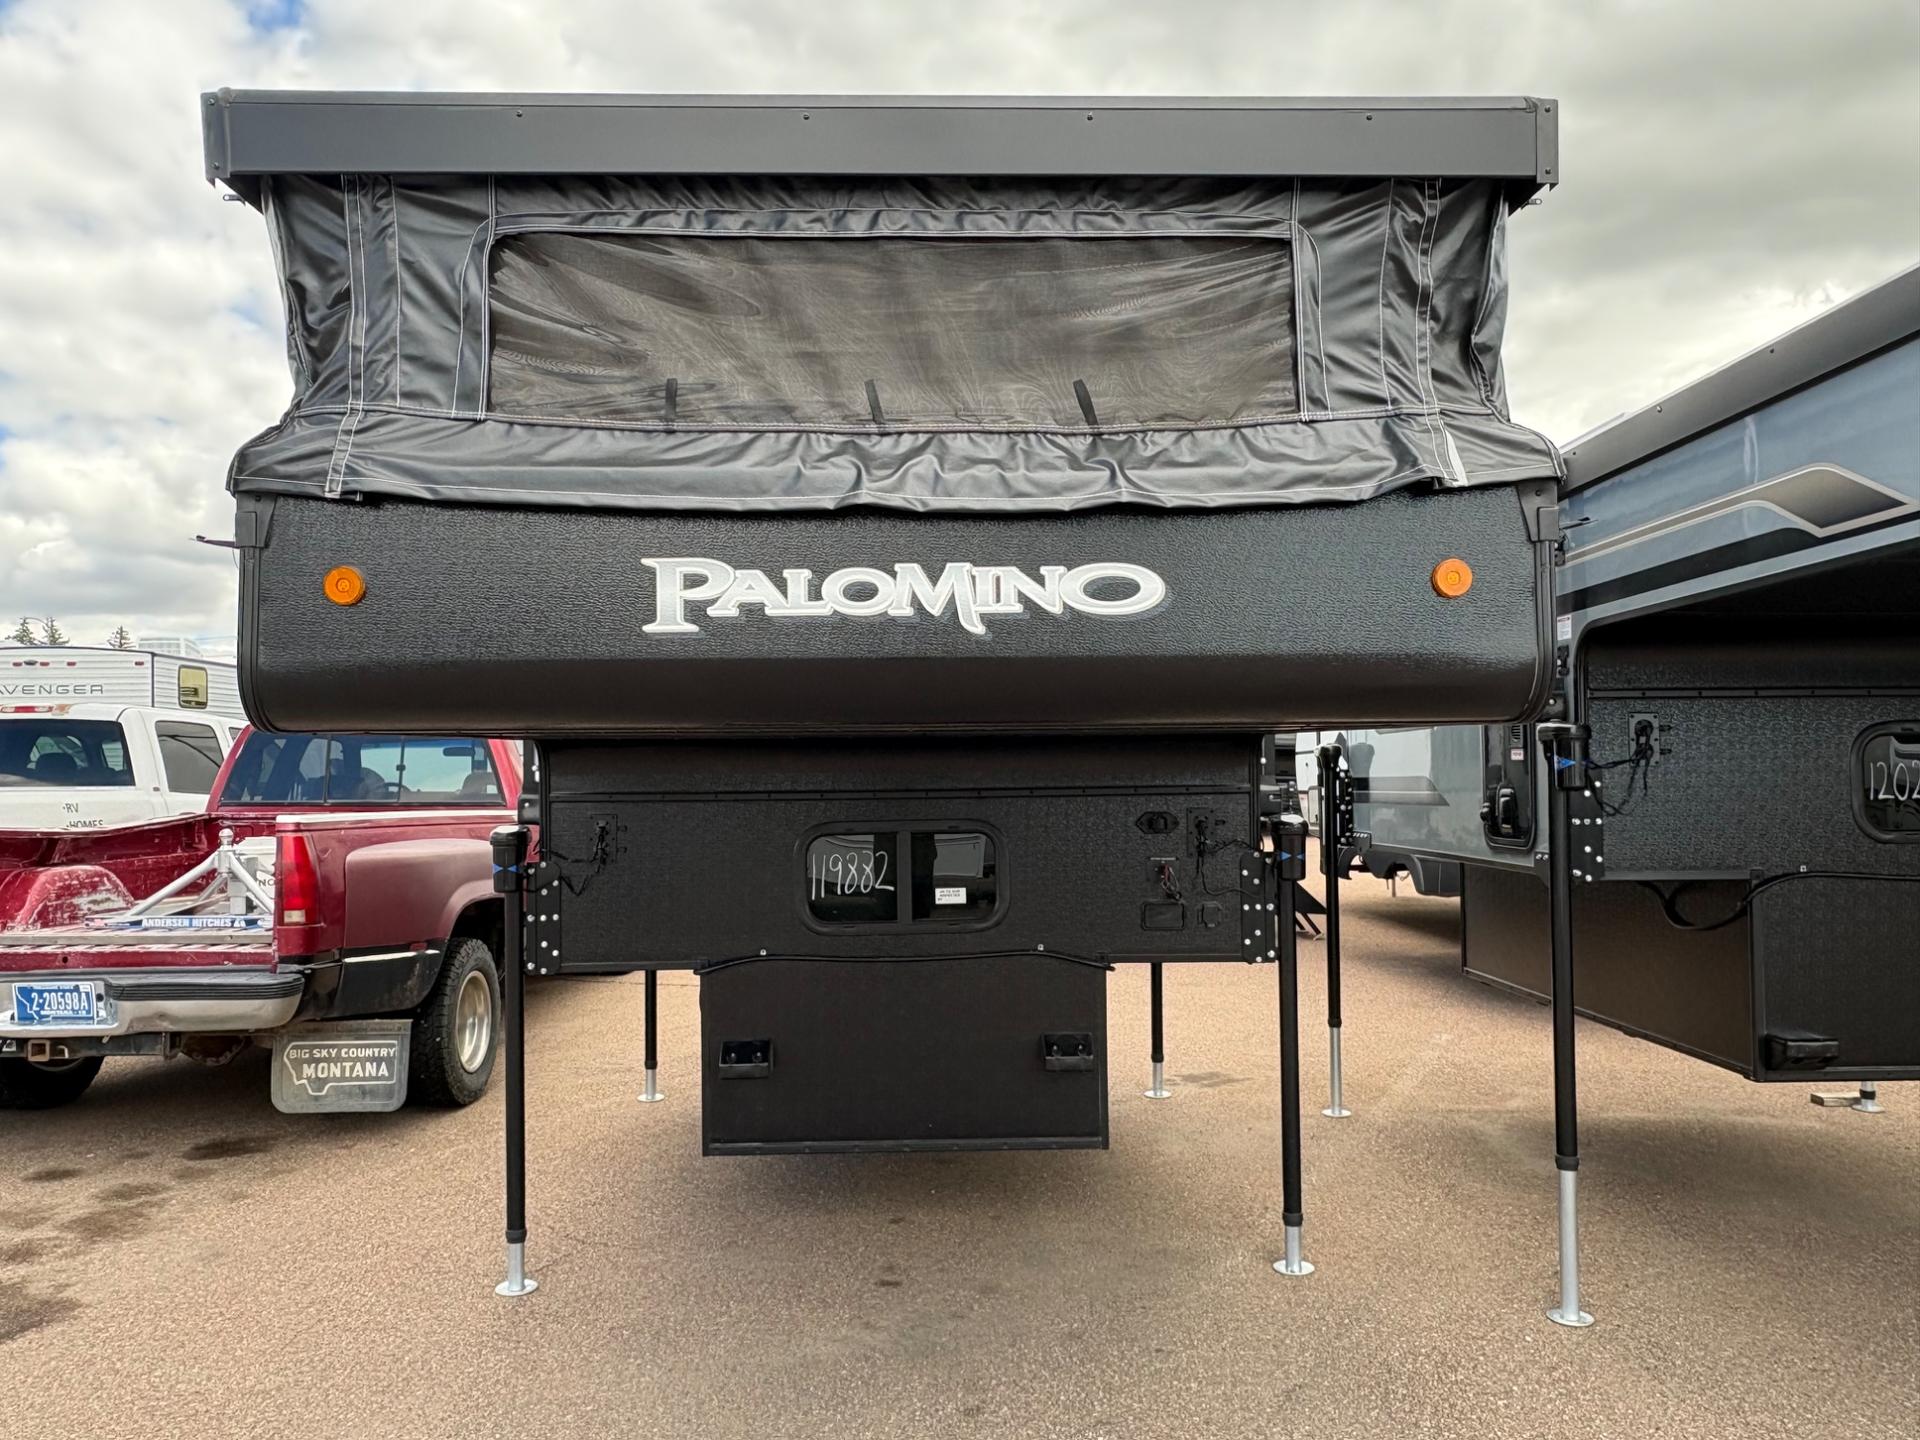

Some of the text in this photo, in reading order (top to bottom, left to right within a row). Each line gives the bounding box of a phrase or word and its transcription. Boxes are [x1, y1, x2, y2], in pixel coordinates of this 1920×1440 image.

[641, 557, 1167, 635] PALOMINO
[0, 684, 104, 695] VENGER
[811, 850, 895, 900] 119882
[142, 918, 232, 928] ANDERSEN HITCHES
[289, 1047, 396, 1059] BIG SKY COUNTRY
[302, 1062, 389, 1079] MONTANA
